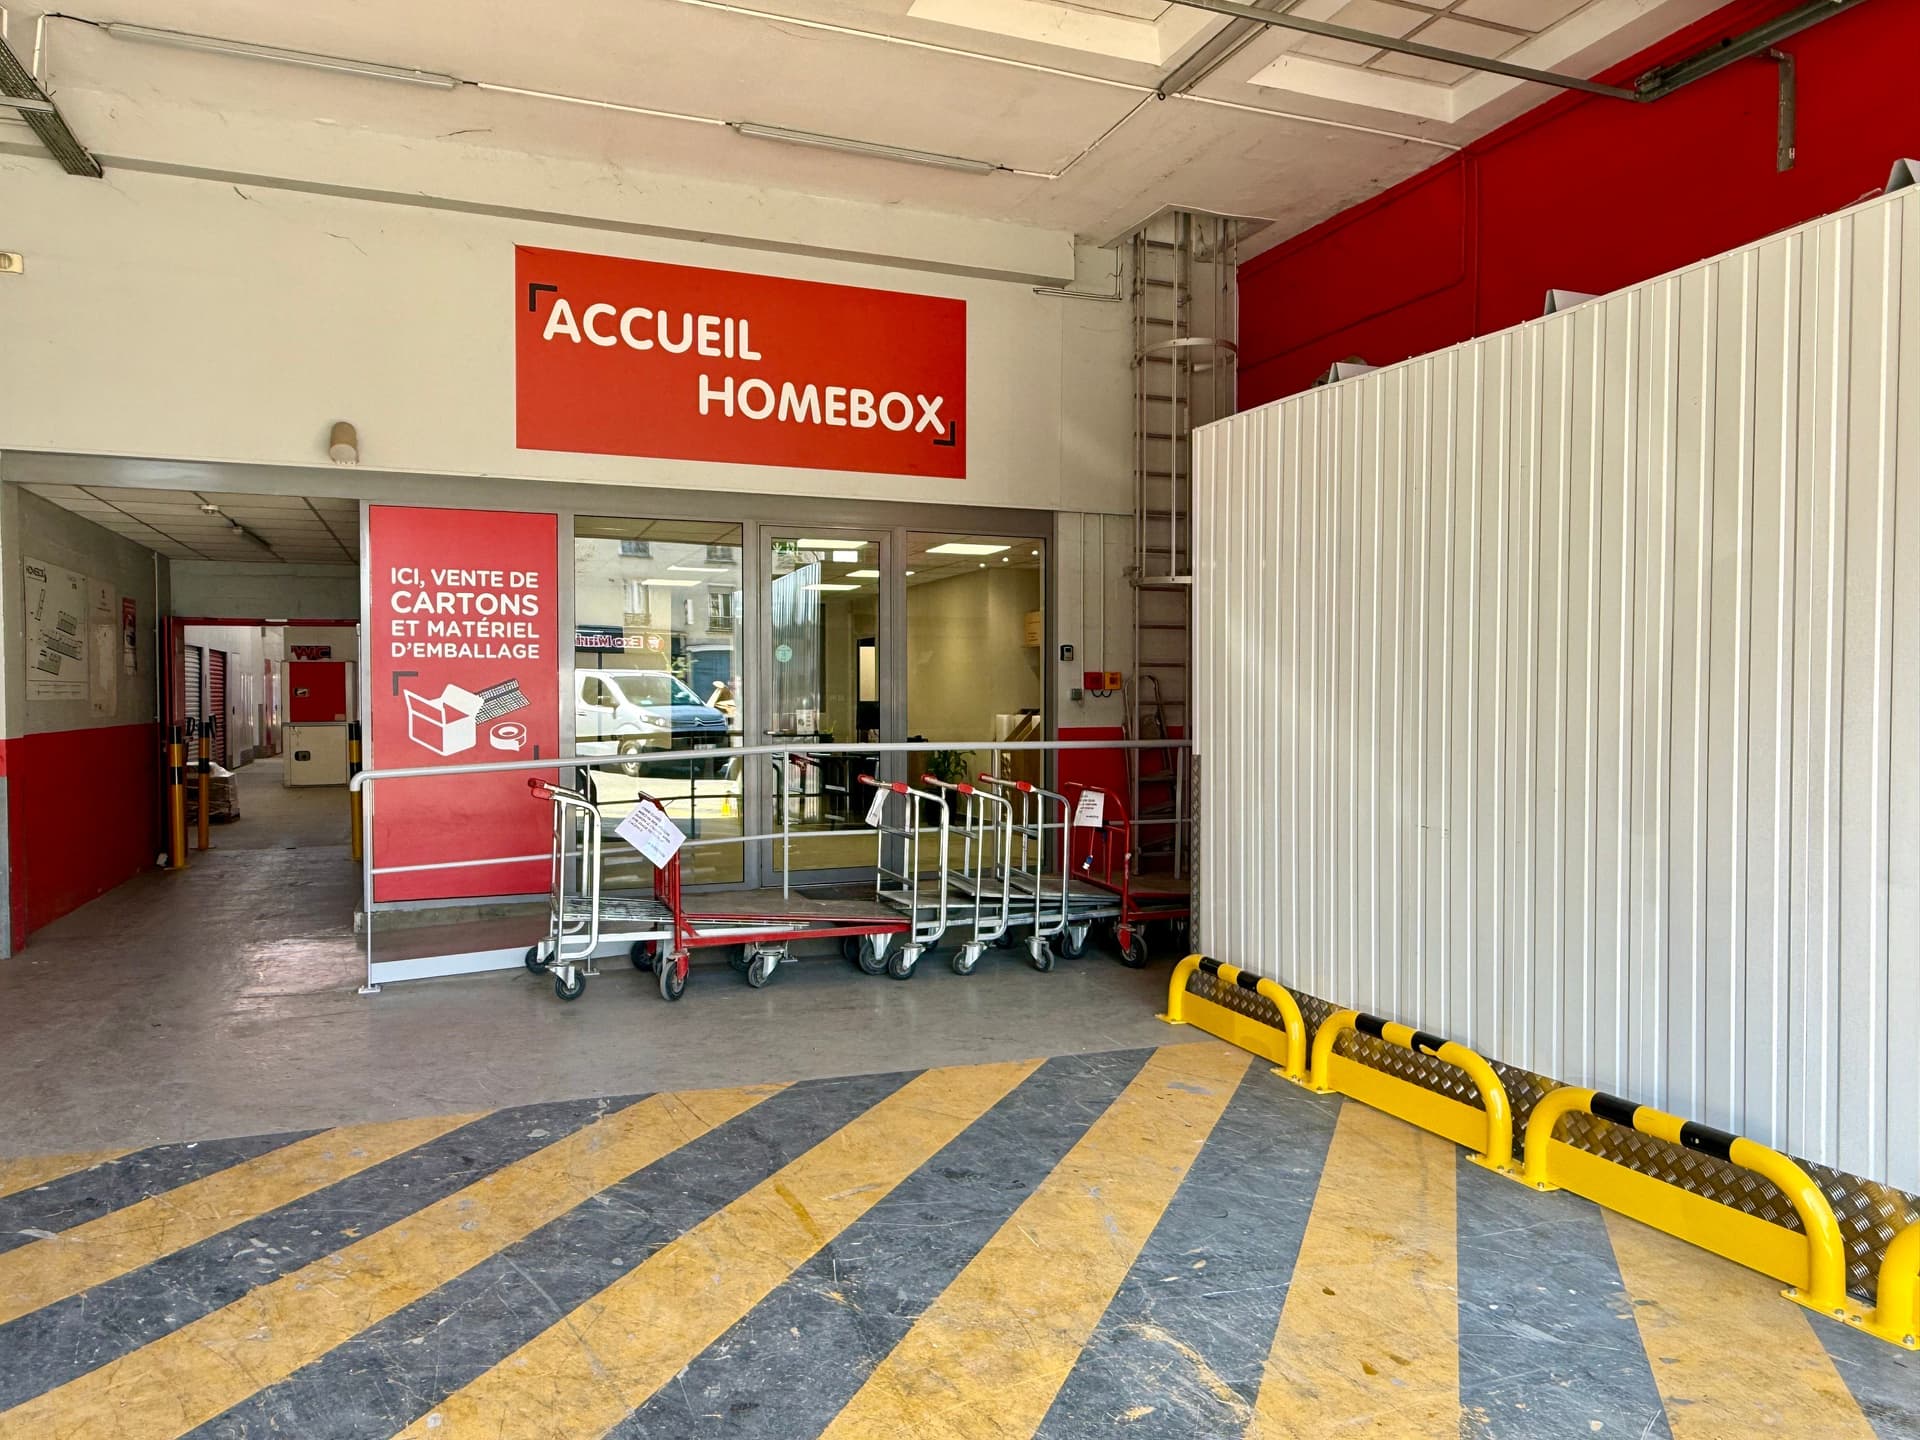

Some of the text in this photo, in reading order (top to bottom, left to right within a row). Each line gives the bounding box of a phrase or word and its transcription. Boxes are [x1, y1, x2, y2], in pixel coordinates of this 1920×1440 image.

[542, 298, 762, 361] ACCUEIL
[698, 374, 946, 434] HOMEBOX
[390, 567, 539, 588] ICI, VENTE DE
[390, 590, 539, 617] CARTONS
[391, 617, 540, 639] ET MATÉRIEL
[391, 642, 540, 659] D’EMBALLAGE
